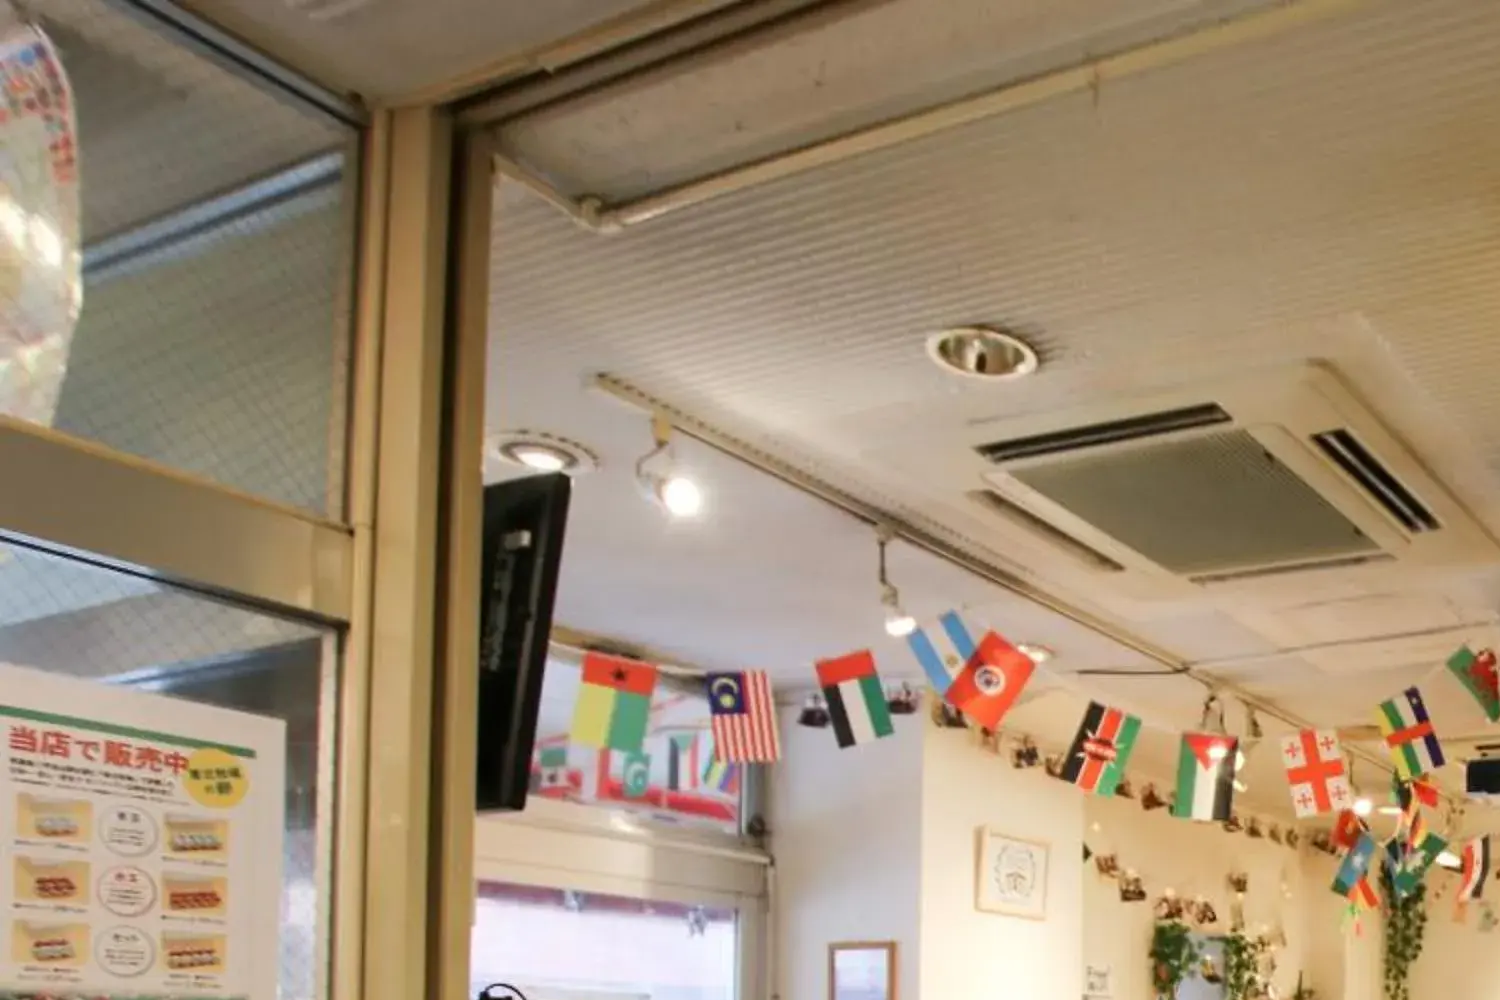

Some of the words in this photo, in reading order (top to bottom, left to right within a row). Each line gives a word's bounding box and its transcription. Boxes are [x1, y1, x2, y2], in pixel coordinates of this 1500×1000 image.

[9, 726, 189, 775] 当店で販売中
